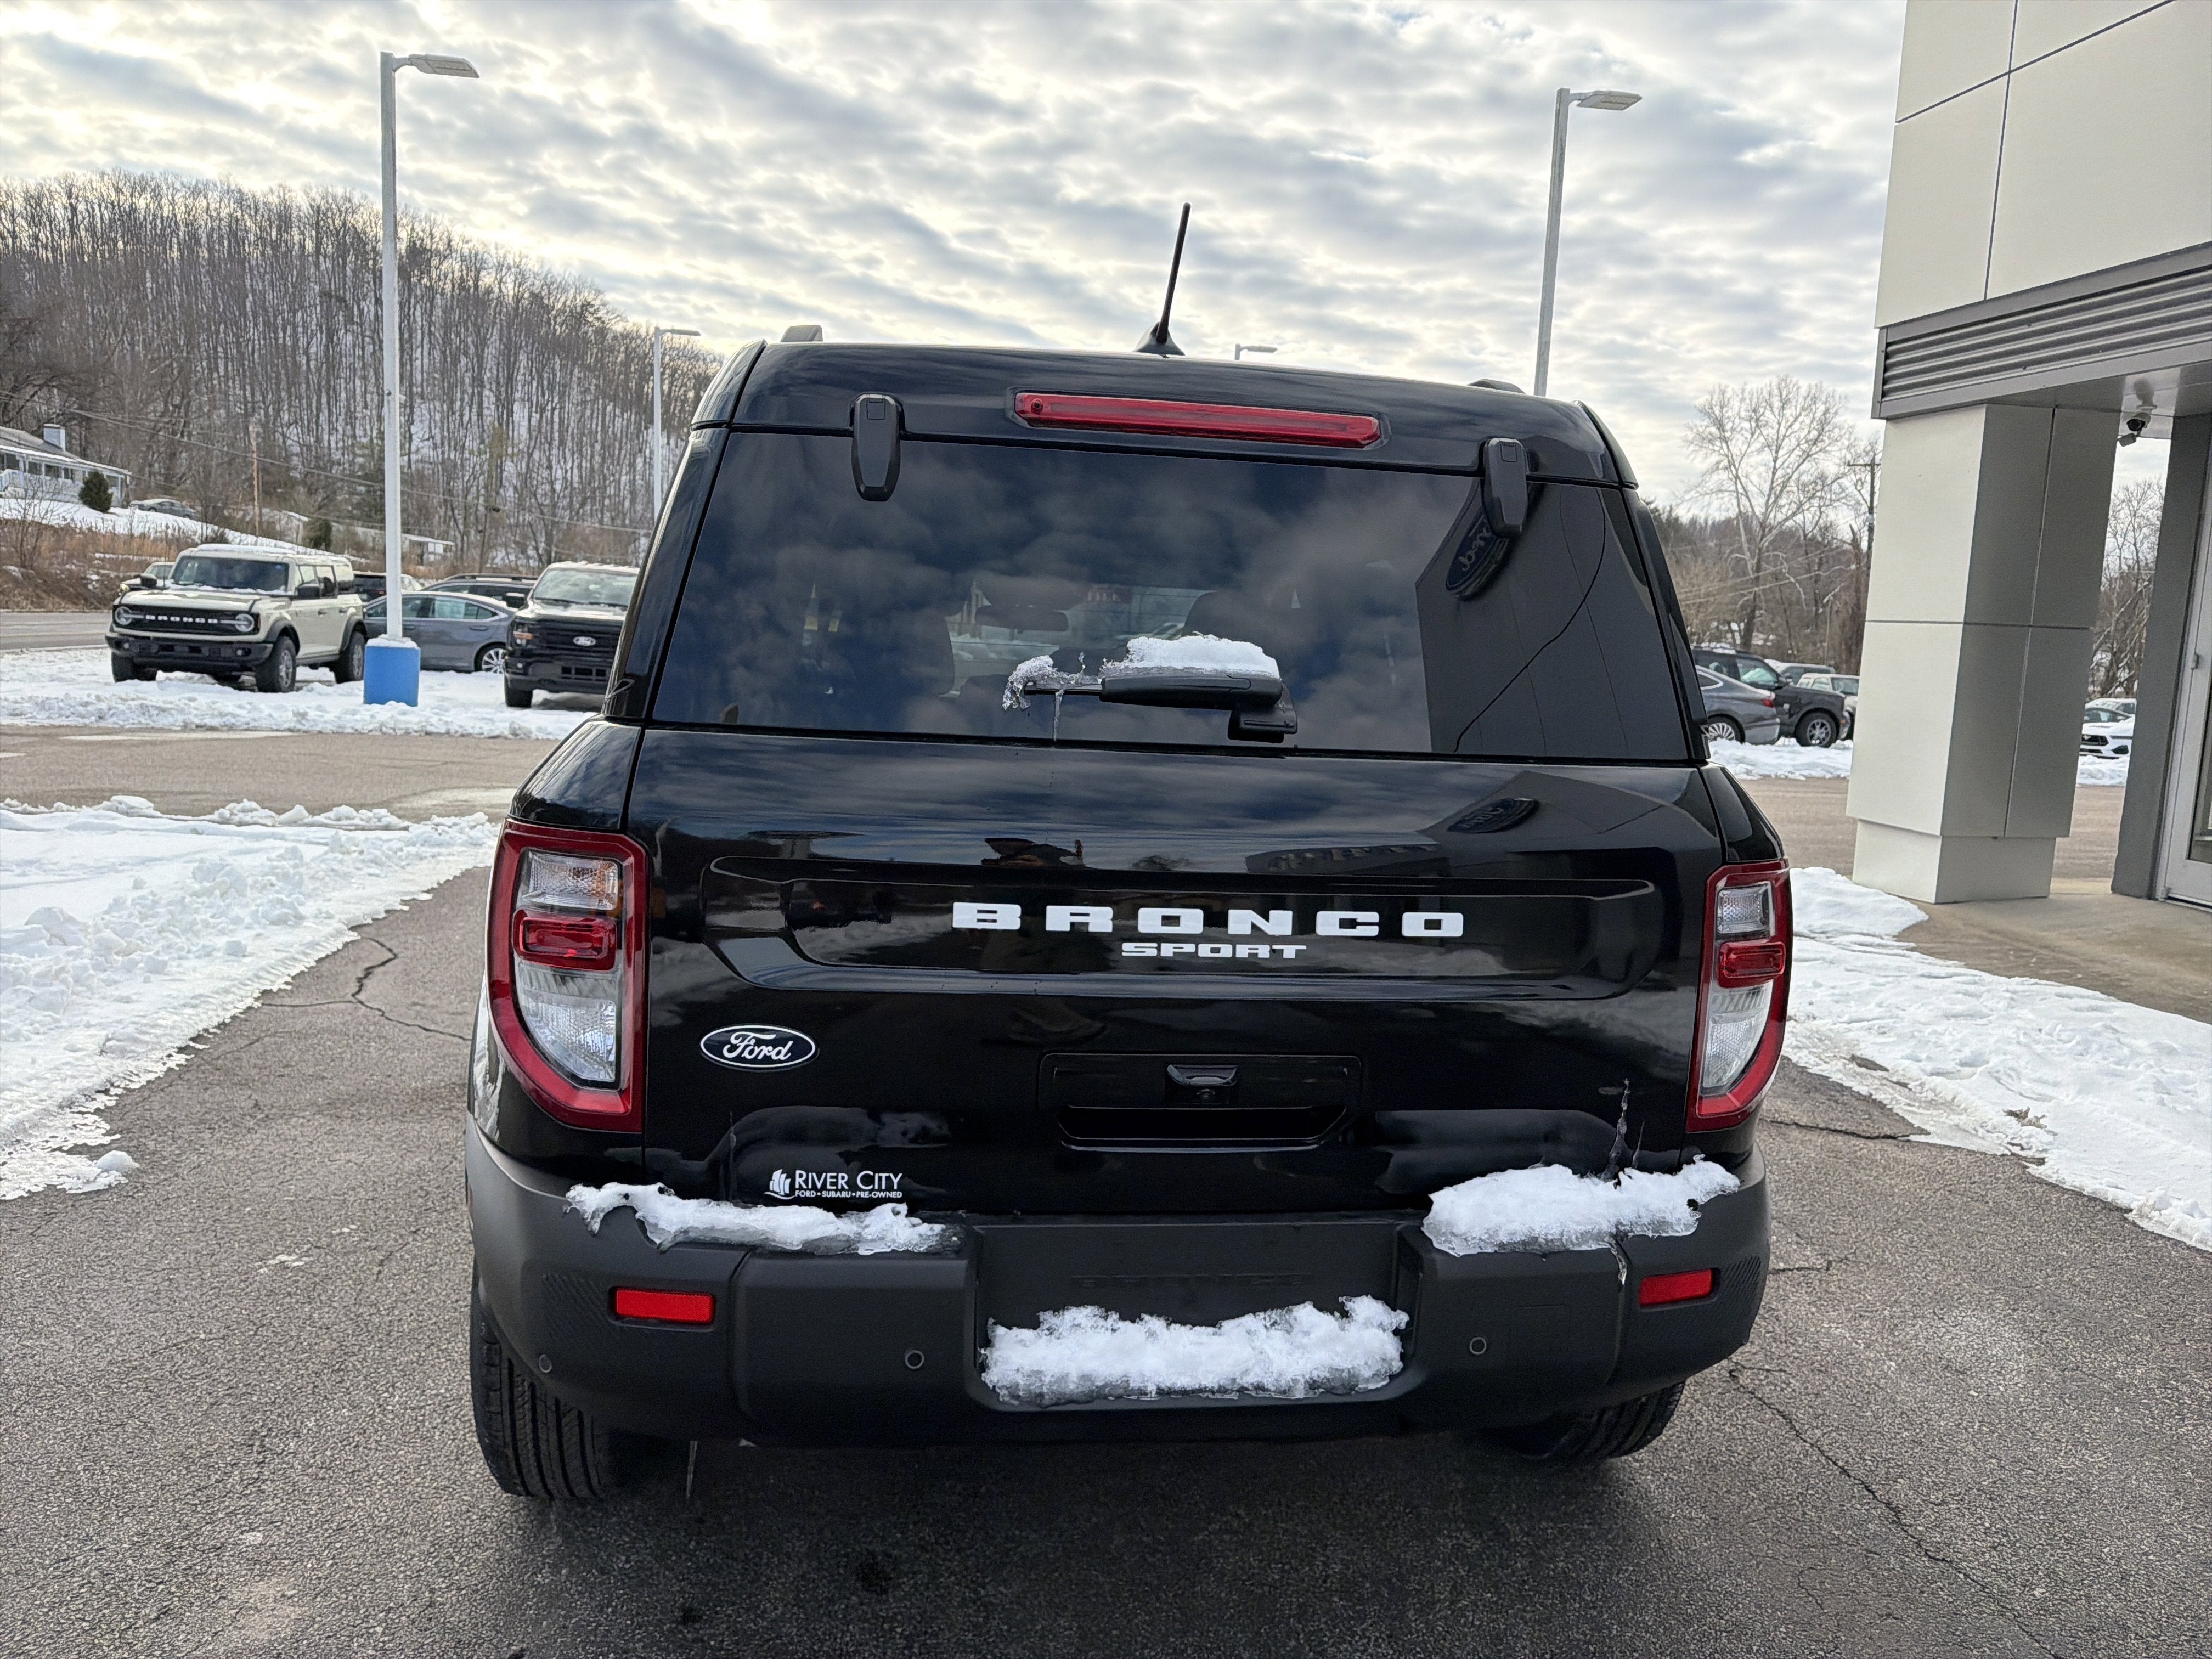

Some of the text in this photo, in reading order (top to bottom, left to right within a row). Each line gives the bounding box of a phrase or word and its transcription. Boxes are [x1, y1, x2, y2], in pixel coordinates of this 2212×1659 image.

[952, 901, 1464, 938] BRONCO
[1121, 941, 1307, 959] SPORT
[723, 1031, 794, 1060] Ford
[795, 1170, 902, 1190] RIVER CITY
